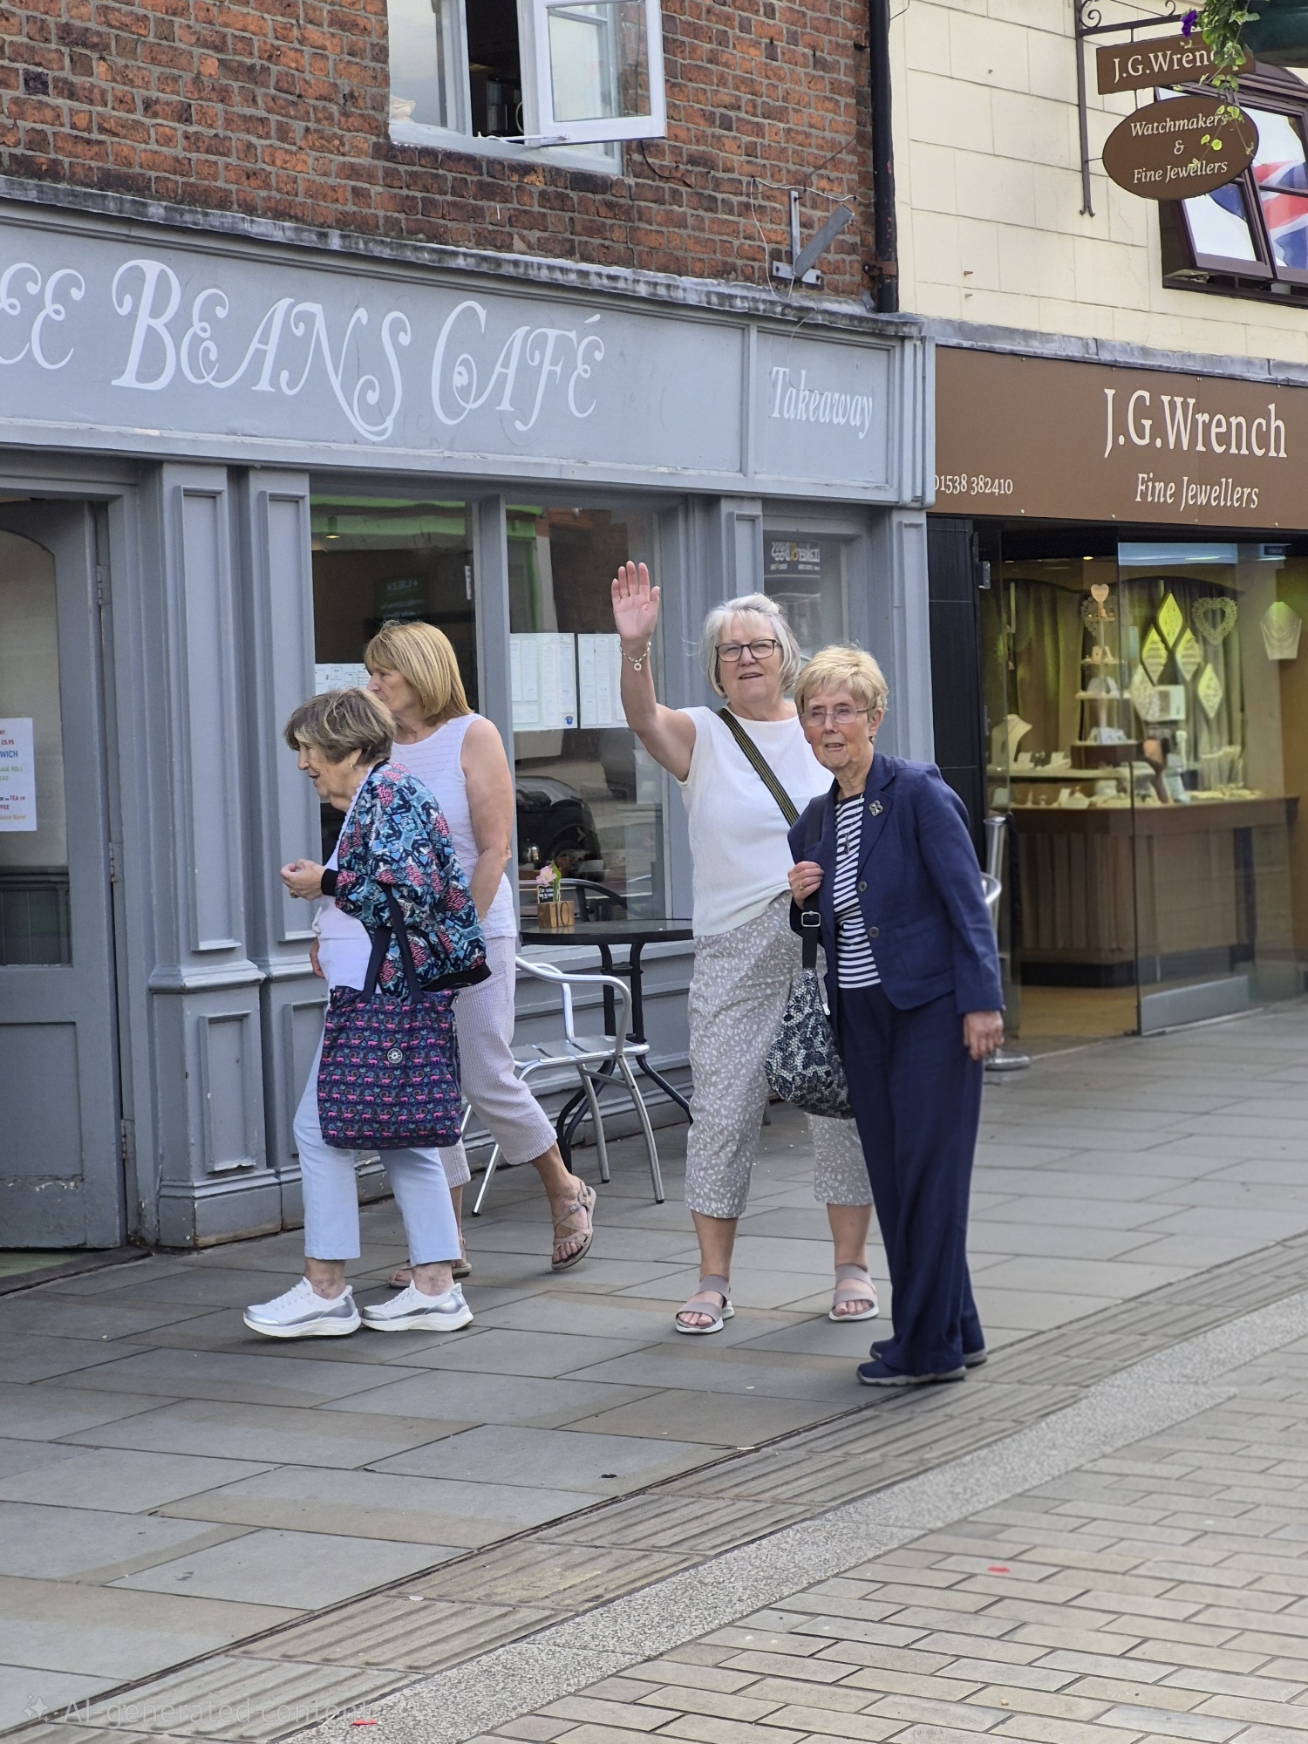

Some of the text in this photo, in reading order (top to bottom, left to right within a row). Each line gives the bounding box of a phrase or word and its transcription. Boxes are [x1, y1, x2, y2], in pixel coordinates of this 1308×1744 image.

[1113, 50, 1218, 84] J.G.Wren
[1130, 113, 1228, 137] Watchmakers
[1173, 139, 1185, 155] &
[1133, 160, 1229, 184] Fine Jewellers
[771, 366, 873, 439] Takeaway
[1104, 387, 1288, 458] J.G.Wrench
[970, 474, 1014, 497] 382410
[1135, 472, 1259, 512] Fine Jewellers
